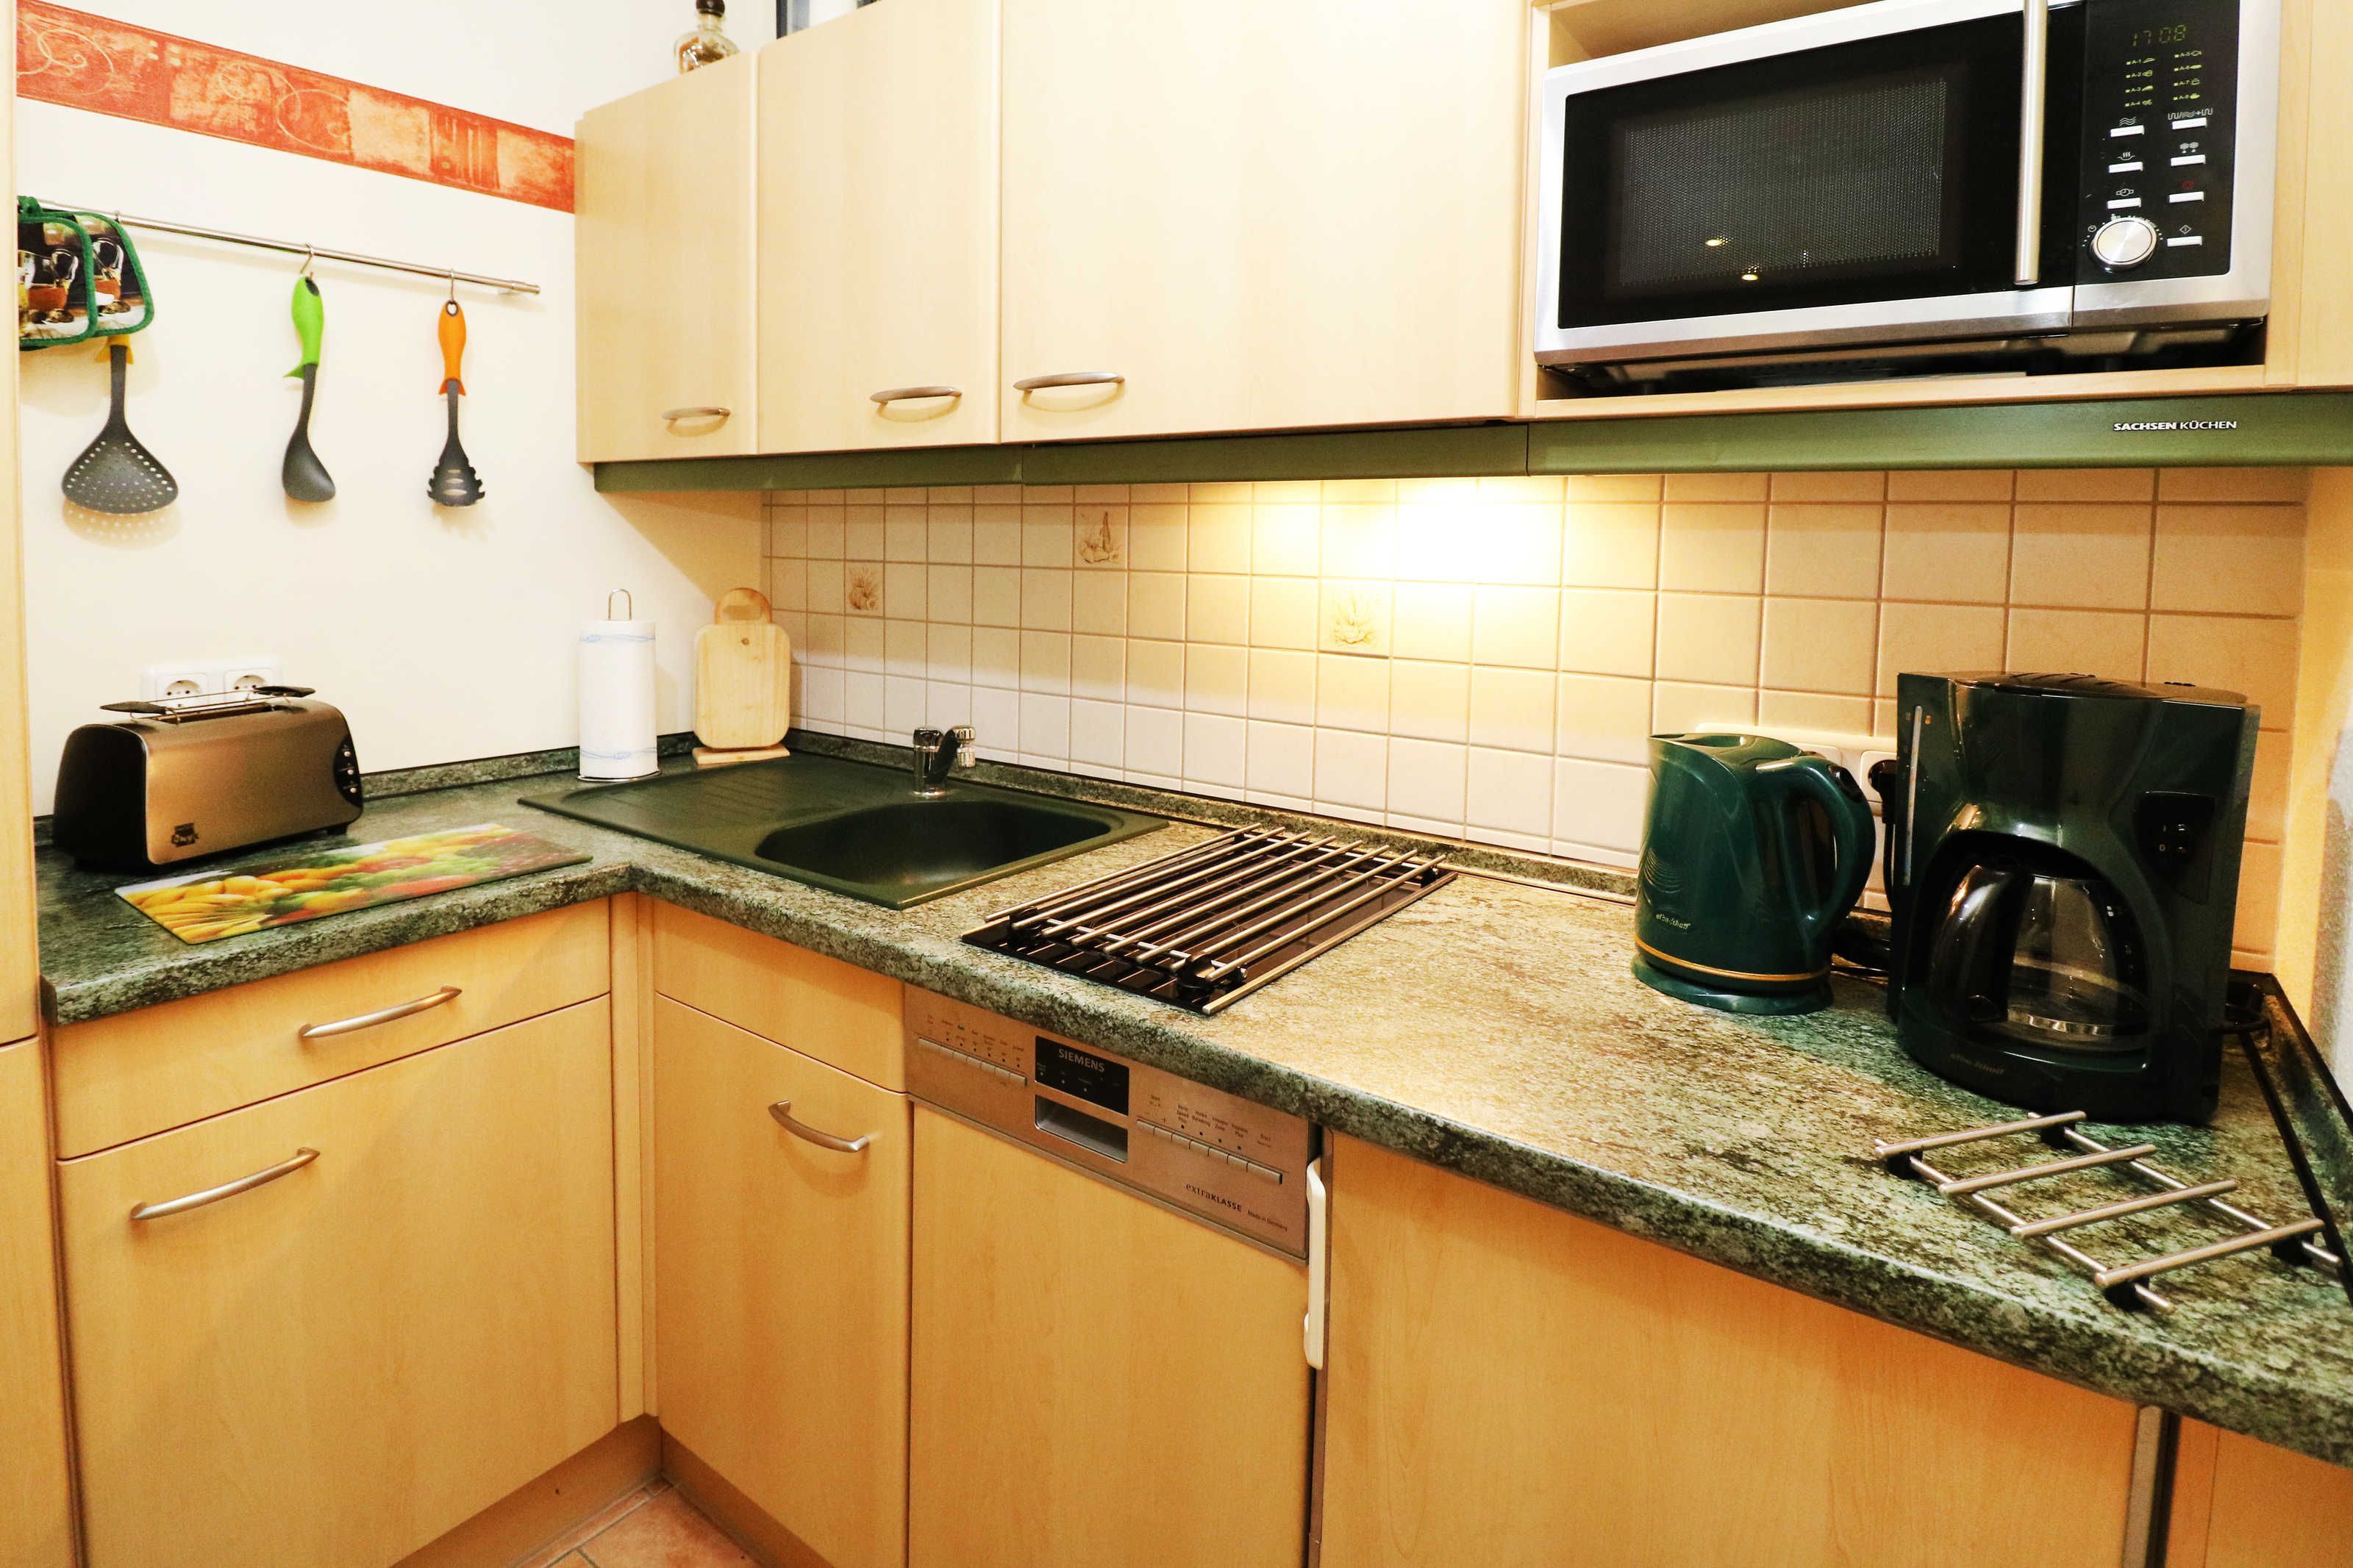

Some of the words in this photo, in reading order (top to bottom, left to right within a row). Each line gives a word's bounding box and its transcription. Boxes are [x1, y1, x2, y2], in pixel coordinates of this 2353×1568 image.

[2113, 422, 2177, 431] SACHSEN
[2179, 420, 2237, 429] KÜCHEN
[1058, 1048, 1105, 1073] SIEMENS
[1185, 1182, 1242, 1212] extraKLASSE
